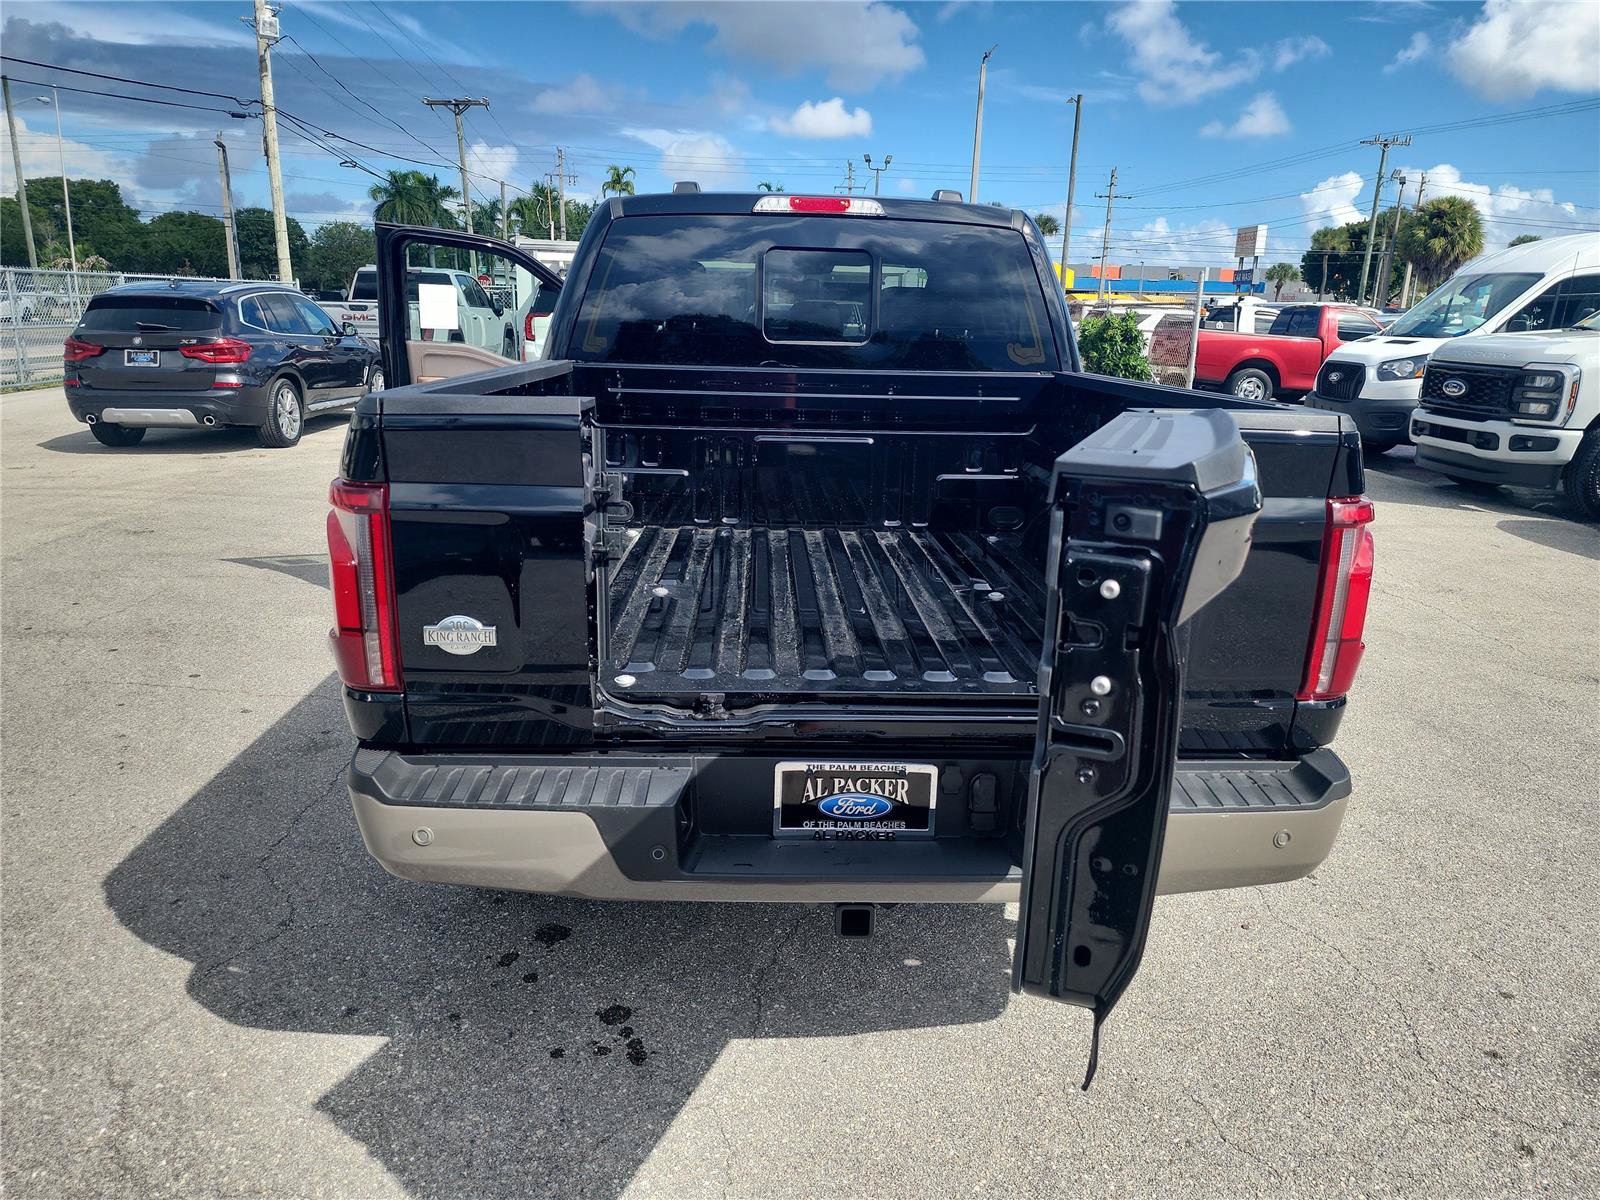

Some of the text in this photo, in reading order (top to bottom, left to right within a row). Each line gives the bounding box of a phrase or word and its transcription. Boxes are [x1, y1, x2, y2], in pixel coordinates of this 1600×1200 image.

[341, 313, 377, 321] GMC
[428, 630, 491, 643] KING RANCH
[801, 777, 910, 805] AL PACKER
[832, 797, 876, 815] Ford
[803, 821, 906, 829] OF THE PALM BEACHES
[812, 831, 896, 841] AL PACKER
